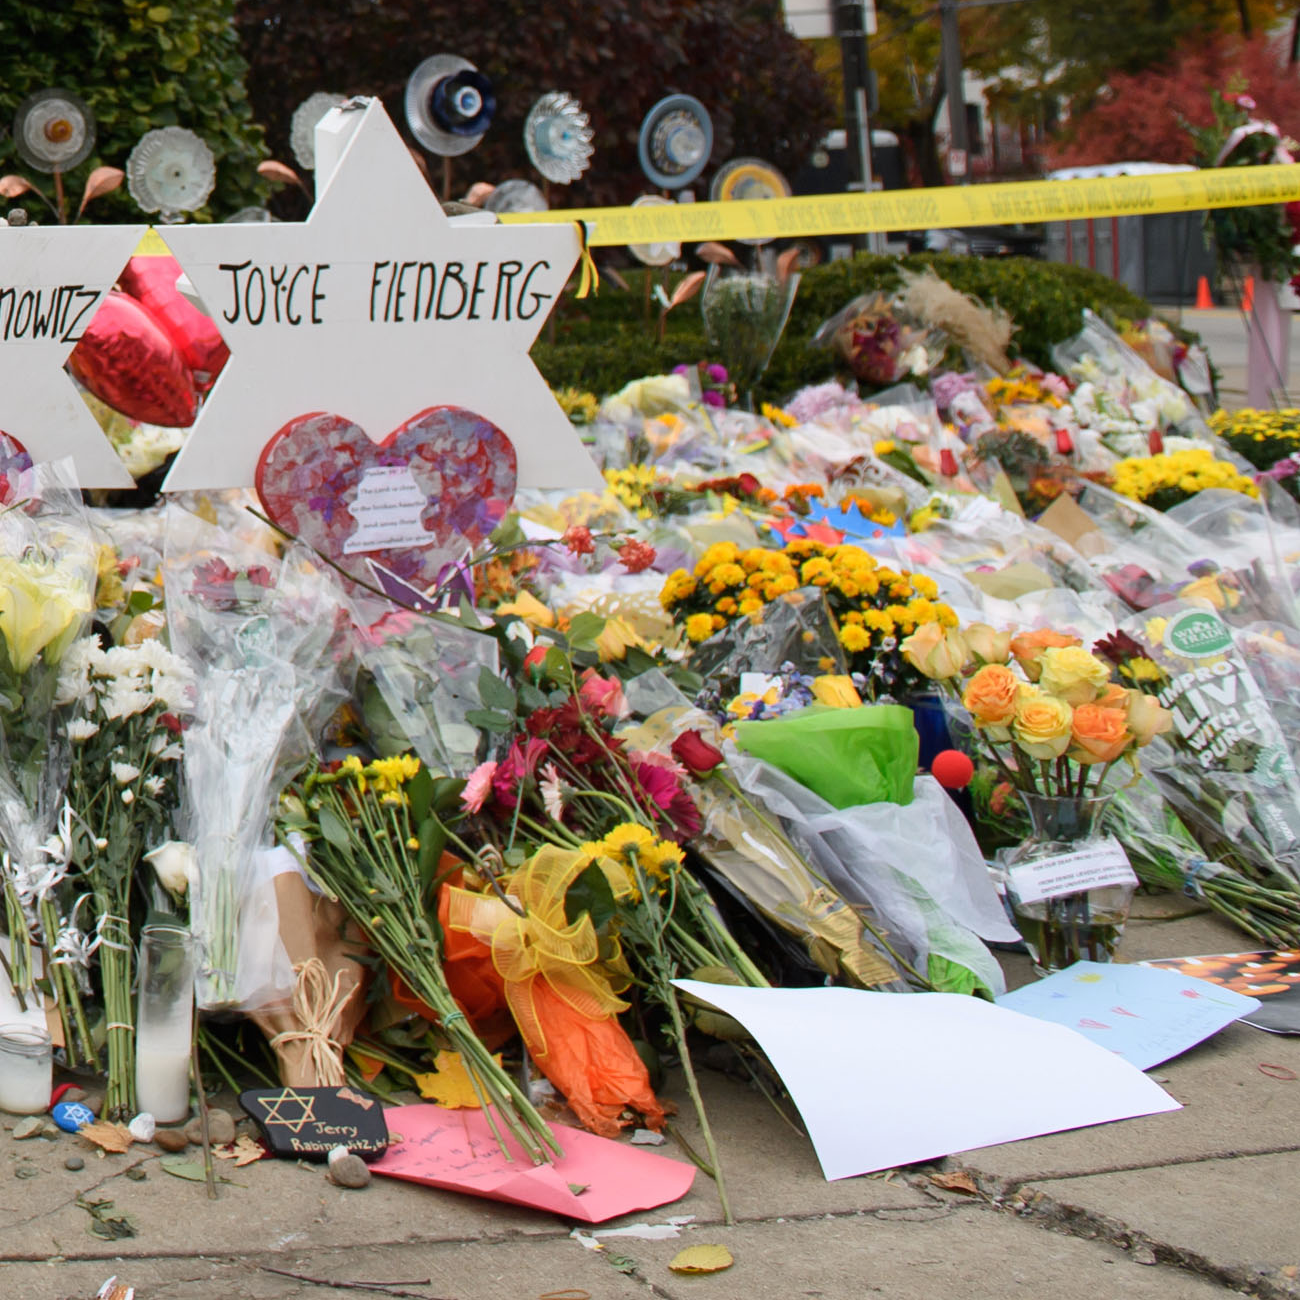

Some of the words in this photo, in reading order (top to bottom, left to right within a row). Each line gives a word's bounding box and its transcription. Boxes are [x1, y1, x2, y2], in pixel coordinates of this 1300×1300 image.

[219, 260, 330, 325] JOYCE
[370, 260, 552, 322] FIENBERG
[312, 1121, 358, 1138] Jerry
